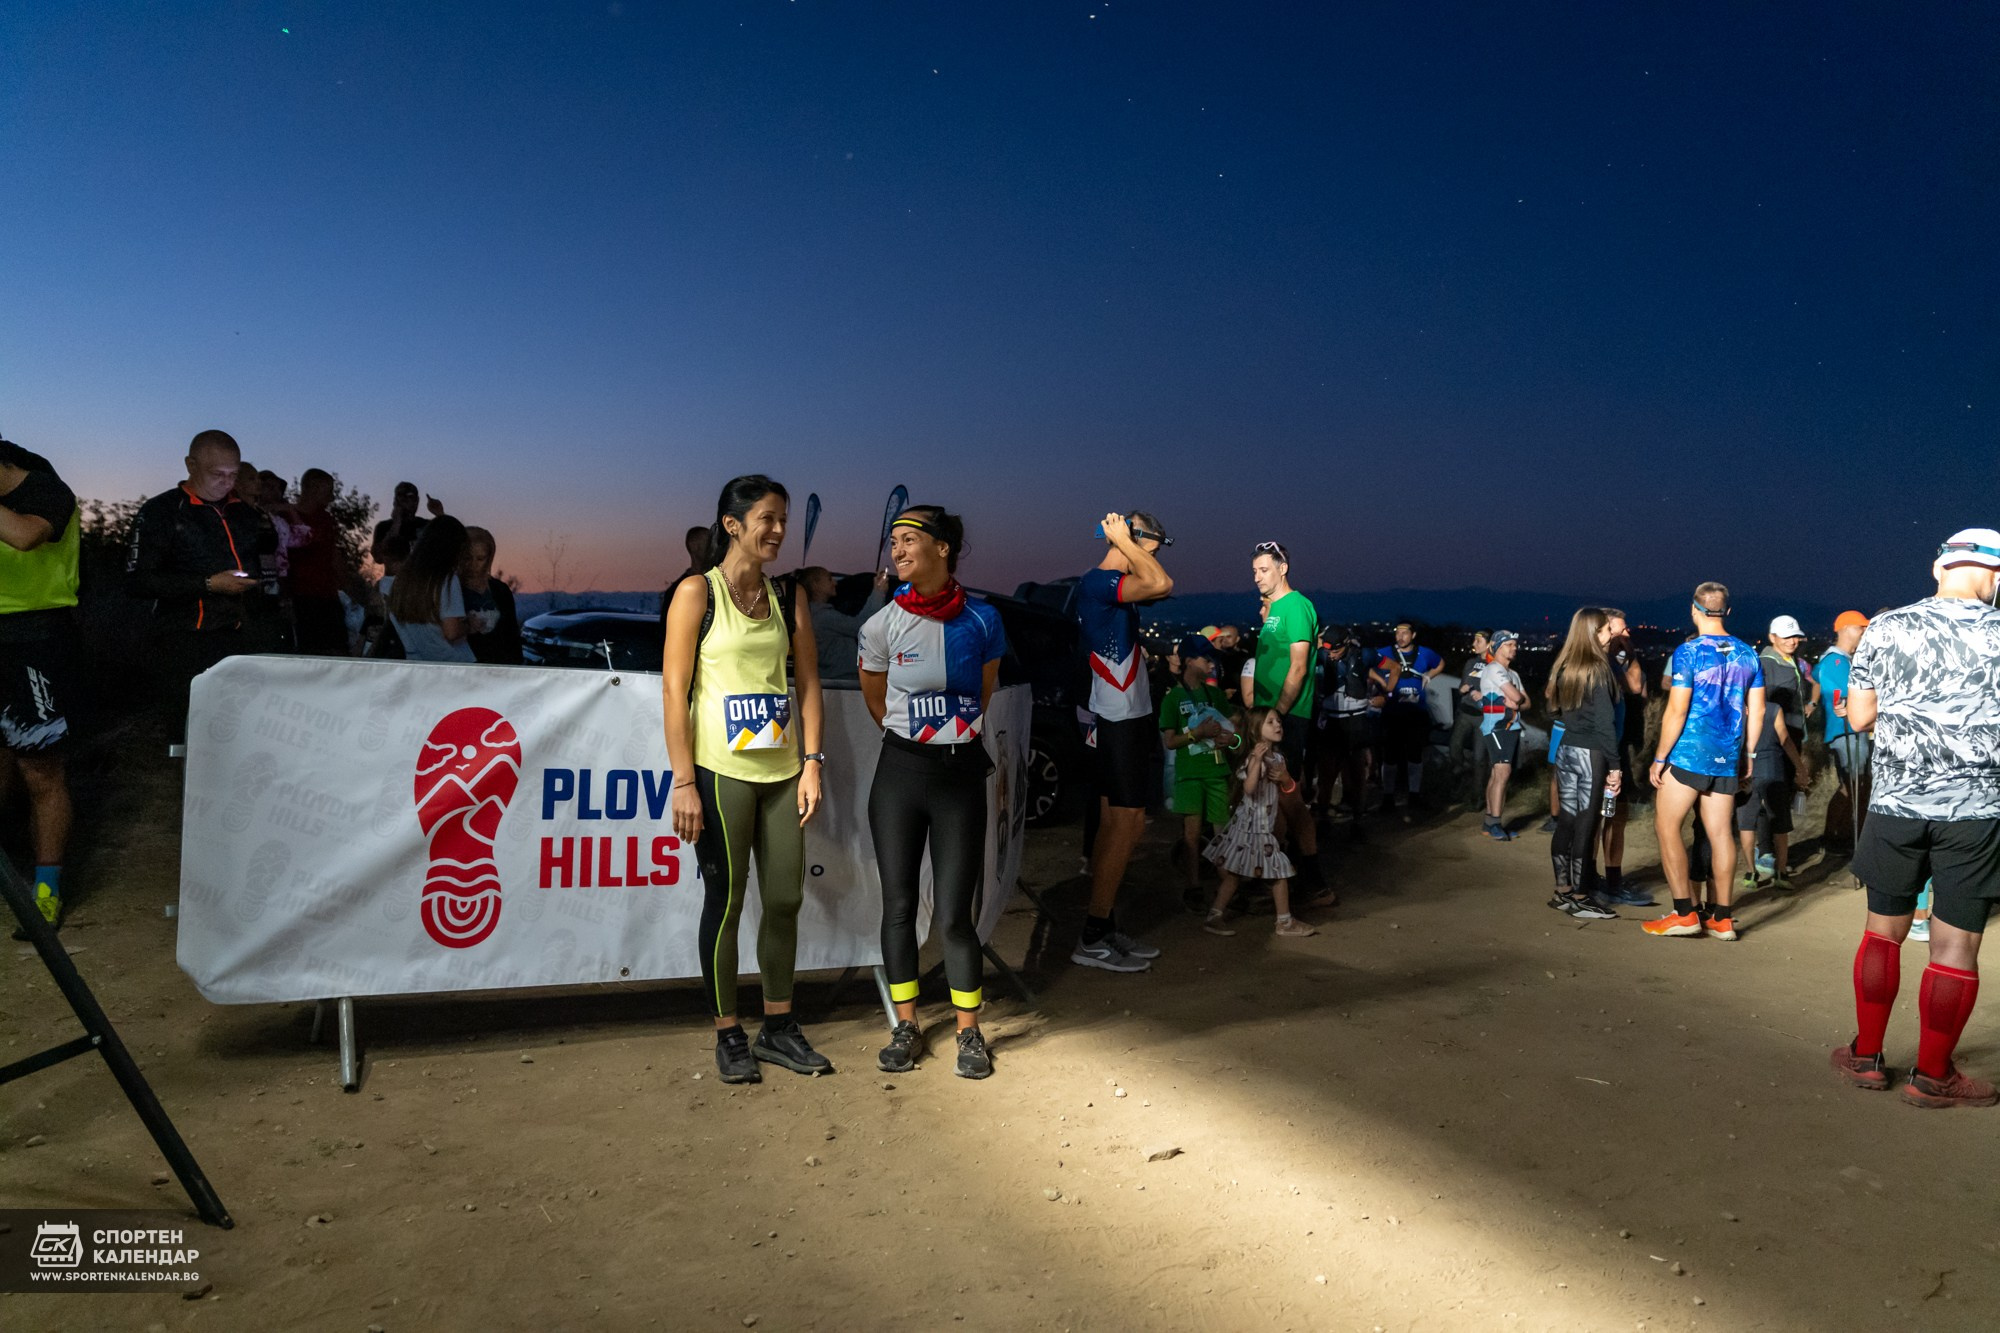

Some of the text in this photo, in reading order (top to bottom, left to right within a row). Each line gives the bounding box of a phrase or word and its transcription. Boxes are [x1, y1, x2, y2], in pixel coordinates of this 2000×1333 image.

[26, 666, 48, 721] NIKE
[729, 698, 769, 721] 0114
[912, 695, 947, 719] 1110
[539, 836, 680, 889] HILLS
